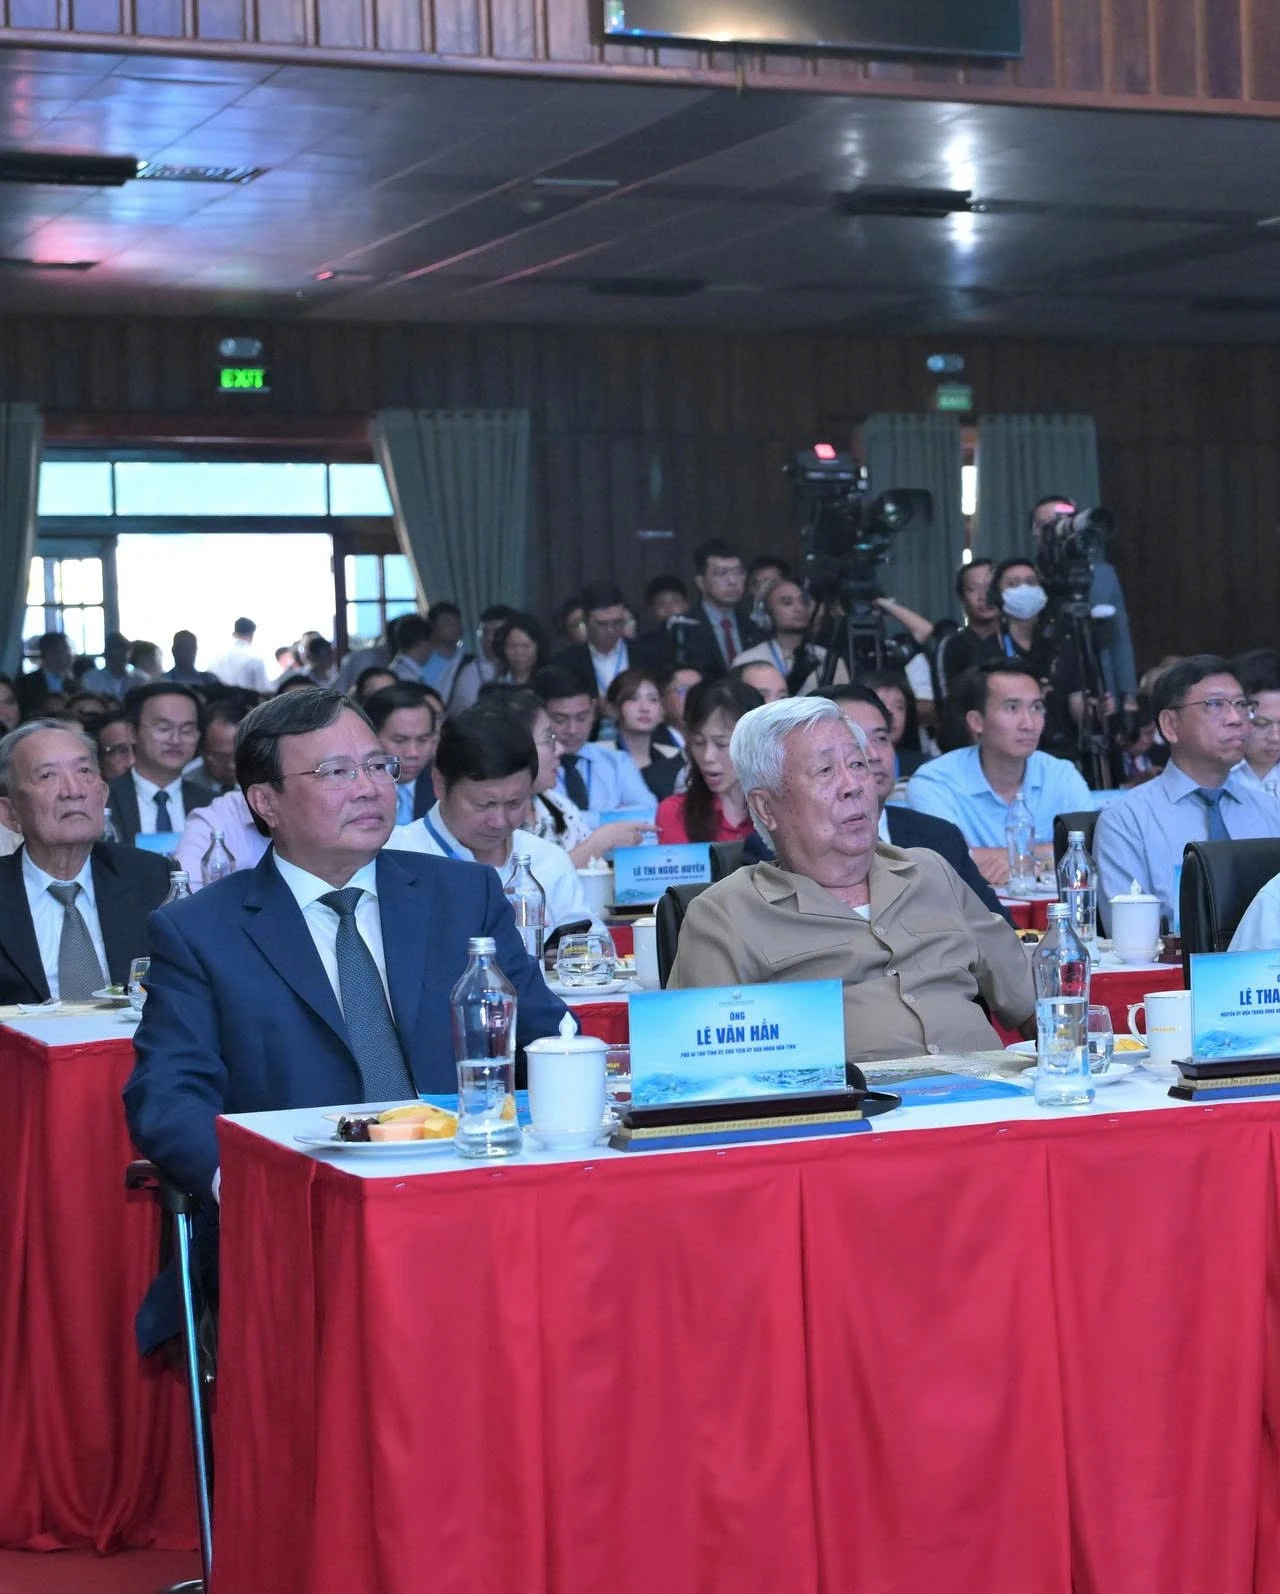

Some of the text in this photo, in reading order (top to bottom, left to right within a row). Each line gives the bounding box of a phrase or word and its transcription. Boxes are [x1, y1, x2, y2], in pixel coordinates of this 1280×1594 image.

[221, 368, 264, 388] EXIT
[1239, 987, 1253, 1006] LÊ
[729, 1011, 745, 1021] ÔNG
[696, 1025, 711, 1045] LÊ
[715, 1025, 745, 1044] VĂN
